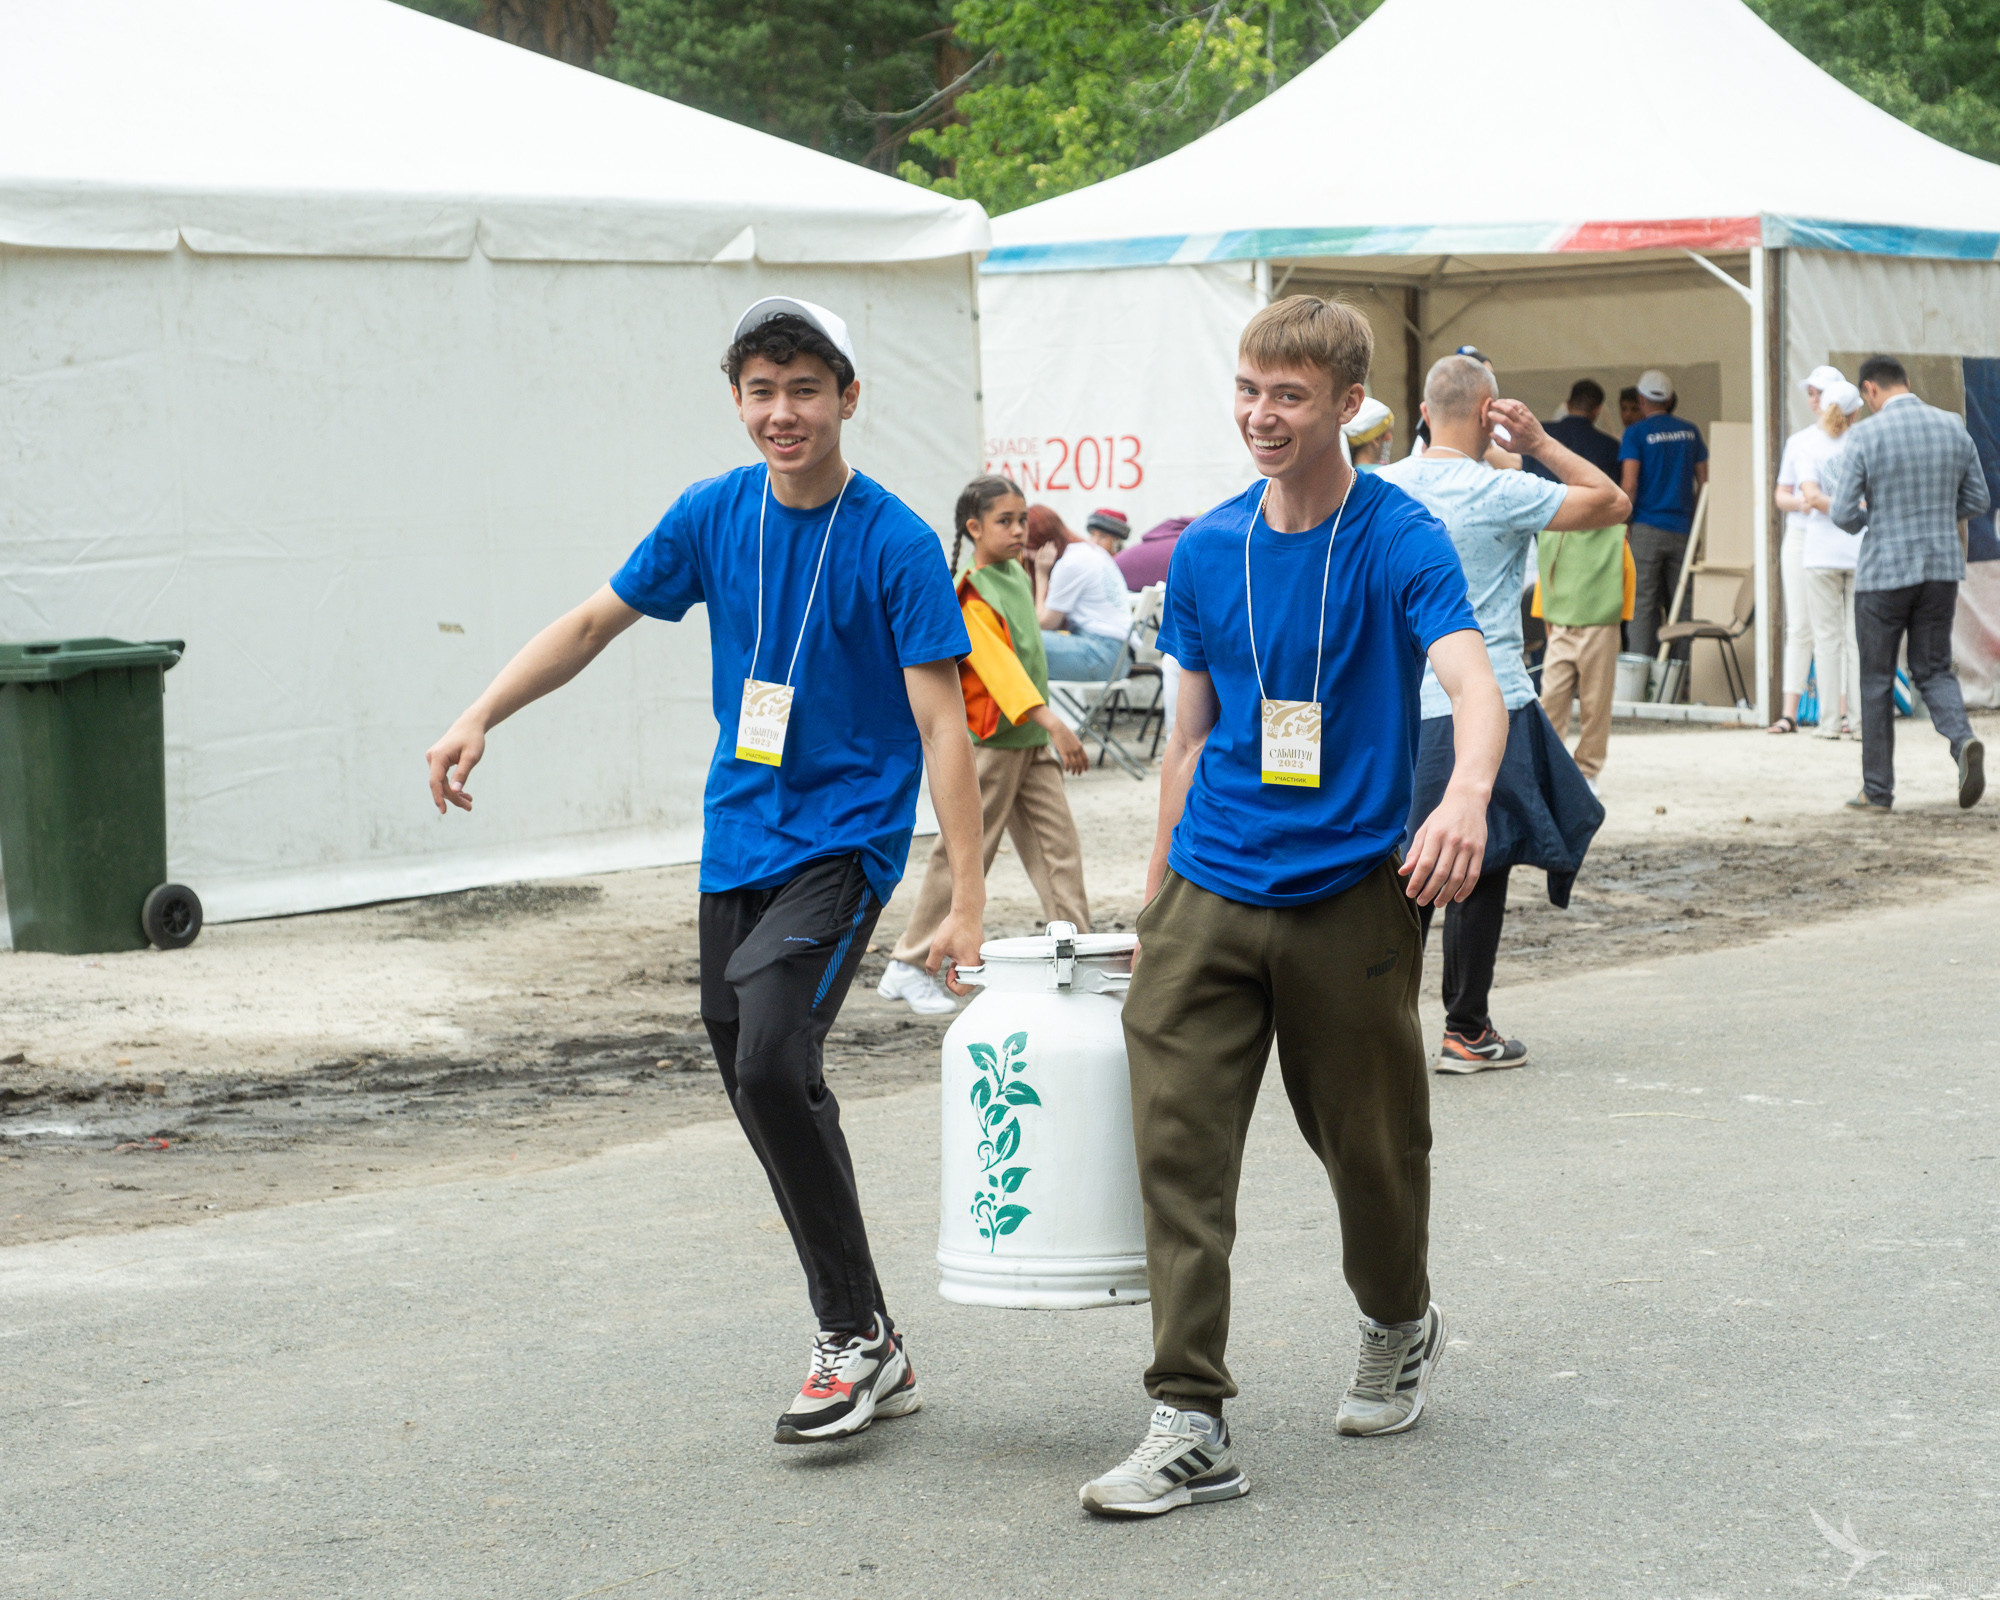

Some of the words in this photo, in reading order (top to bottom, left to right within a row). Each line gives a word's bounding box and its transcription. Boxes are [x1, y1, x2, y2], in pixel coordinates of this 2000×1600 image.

[985, 437, 1038, 456] SIADE
[985, 461, 1039, 491] AN
[1046, 436, 1143, 490] 2013
[750, 737, 771, 747] 2023
[1278, 760, 1304, 769] 2023
[1274, 776, 1307, 784] УЧАСТНИК
